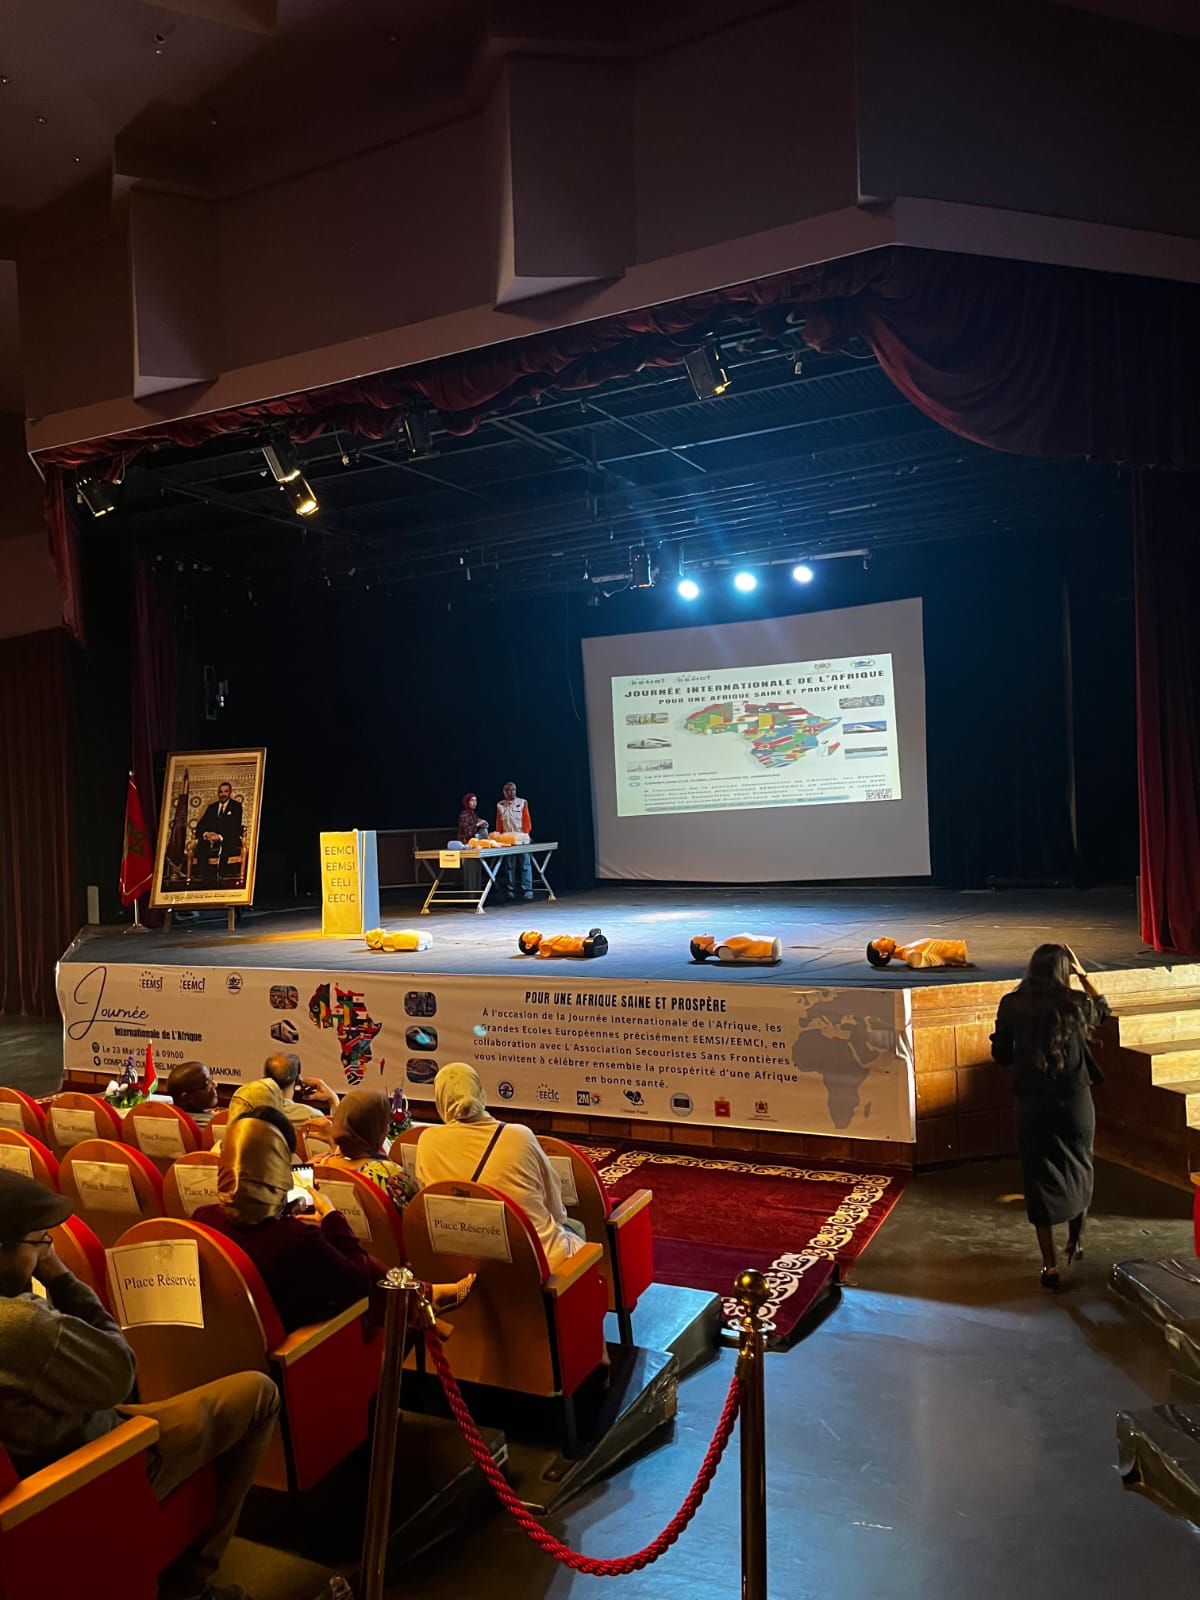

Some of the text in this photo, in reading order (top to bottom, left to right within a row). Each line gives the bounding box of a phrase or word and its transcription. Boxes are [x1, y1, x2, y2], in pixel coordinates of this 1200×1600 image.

[624, 687, 682, 698] JOURNÉE
[687, 679, 792, 694] INTERNATIONALE
[798, 676, 814, 685] DE
[819, 670, 885, 682] L'AFRIQUE
[710, 693, 750, 701] AFRIQUE
[754, 689, 782, 697] SAINE
[801, 683, 851, 693] PROSPÈRE
[325, 845, 355, 856] EEMCI
[326, 861, 355, 872] EEMSI
[331, 878, 351, 887] EELI
[328, 893, 356, 903] EECIC
[68, 966, 149, 1041] Journée
[525, 991, 727, 1013] POUR UNE AFRIQUE SAINE ET PROSPÈRE
[482, 1007, 782, 1033] À l'occasion de la Journée Internationale de l'Afrique, les
[114, 1026, 203, 1042] Internationale de L'Afrique
[480, 1023, 786, 1049] Grandes Ecoles Européennes précisément EEMSI/EEMCI, en
[122, 1047, 135, 1055] Mai
[155, 1049, 160, 1057] à
[161, 1051, 184, 1059] 09h00
[473, 1038, 536, 1049] collaboration
[539, 1042, 561, 1050] avec
[564, 1042, 632, 1055] L'Association
[635, 1047, 697, 1059] Secouristes
[700, 1051, 726, 1061] Sans
[730, 1053, 790, 1065] Frontières
[474, 1053, 798, 1085] vous invitent à célébrer ensemble la prospérité d'une Afrique
[585, 1075, 669, 1089] en bonne santé.
[577, 1092, 590, 1105] 2M
[183, 1186, 203, 1197] Place
[434, 1219, 501, 1237] Place Réservée
[124, 1273, 197, 1291] Place Réservée
